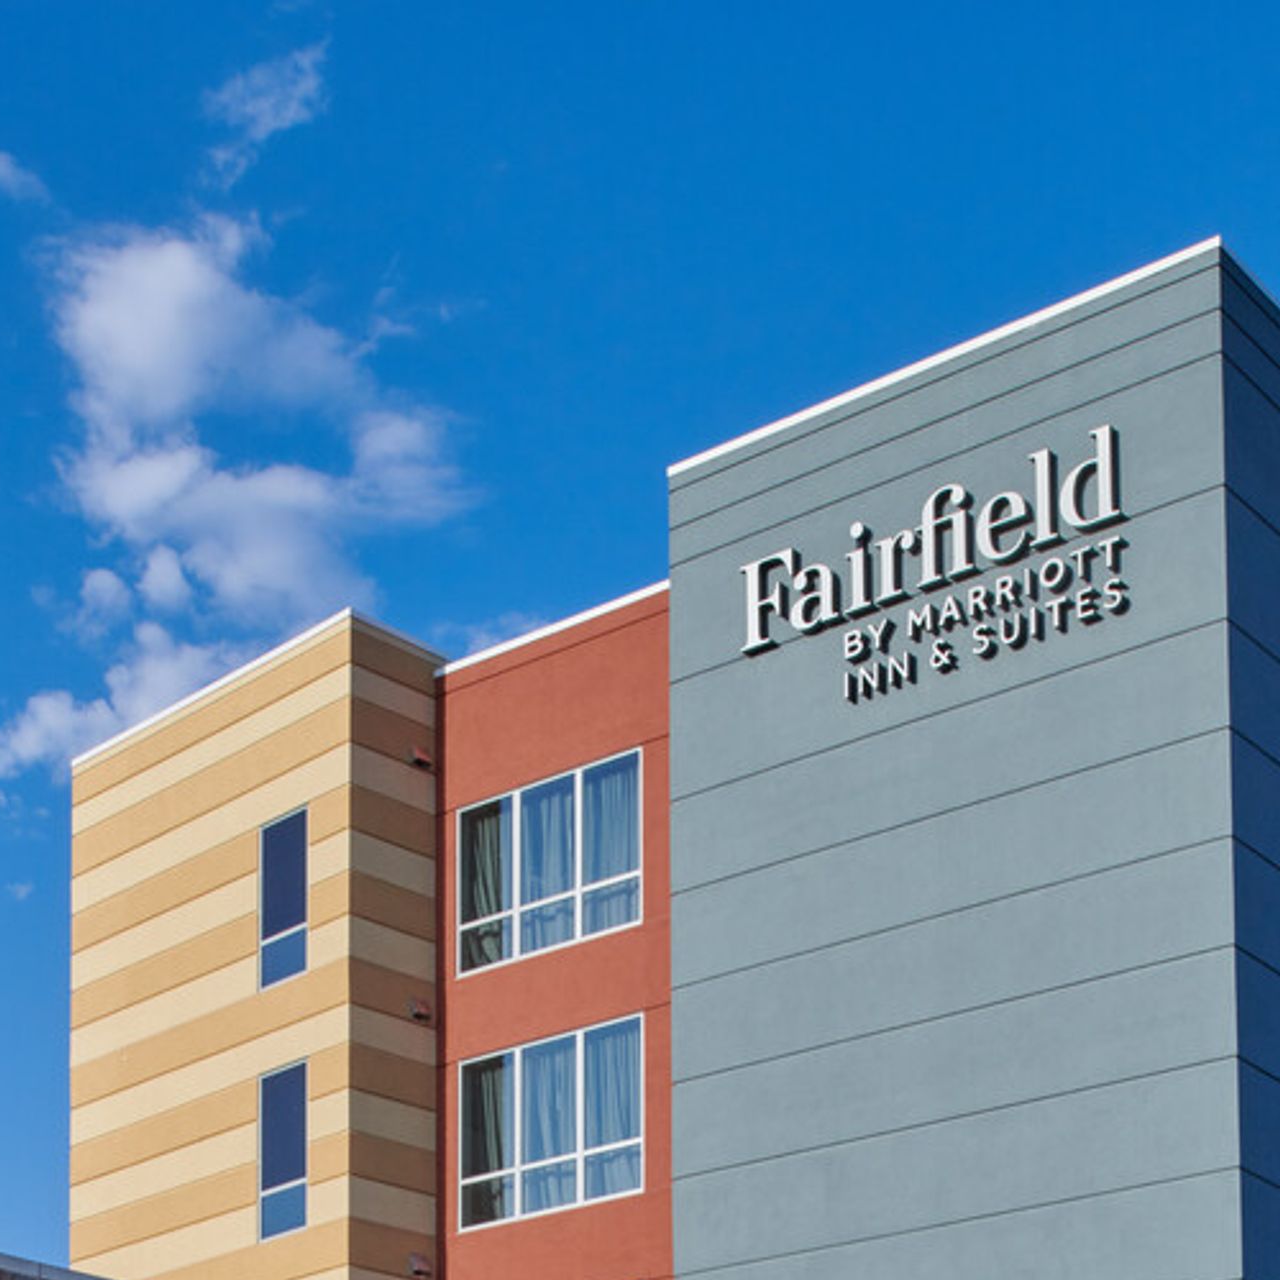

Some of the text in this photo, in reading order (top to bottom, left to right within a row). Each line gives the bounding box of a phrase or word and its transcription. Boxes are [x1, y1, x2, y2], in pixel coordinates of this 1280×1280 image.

[740, 424, 1126, 656] Fairfield
[844, 536, 1127, 661] BY MARRIOTT
[844, 578, 1127, 700] INN & SUITES
